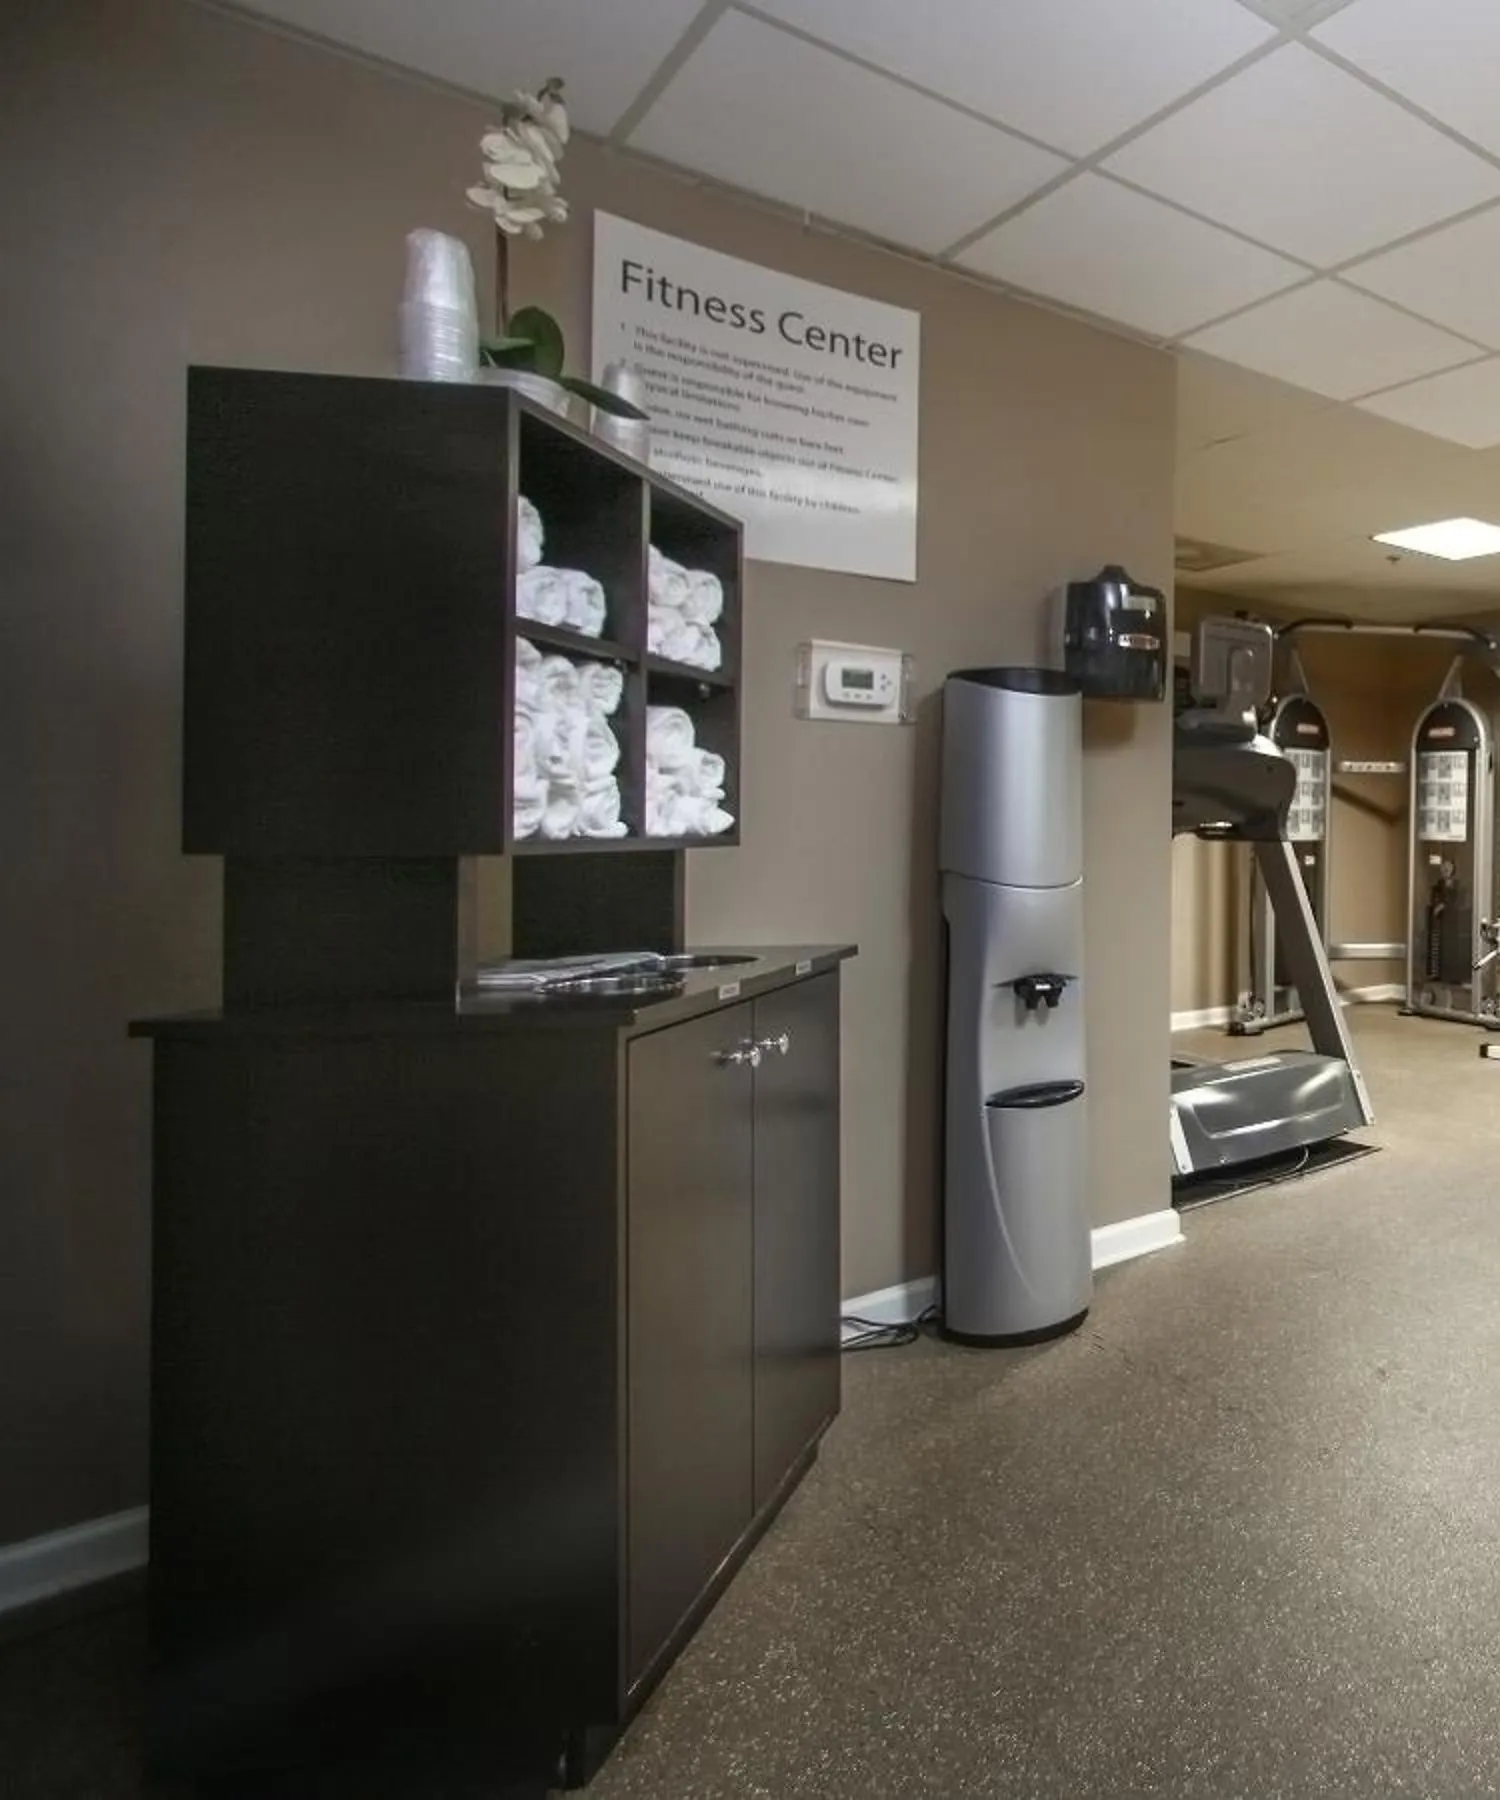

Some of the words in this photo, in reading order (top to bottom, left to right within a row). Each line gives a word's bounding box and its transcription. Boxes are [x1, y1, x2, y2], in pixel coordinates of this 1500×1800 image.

[620, 259, 765, 335] Fitness
[778, 310, 904, 369] Center
[659, 333, 695, 352] facility
[681, 374, 744, 399] responsible
